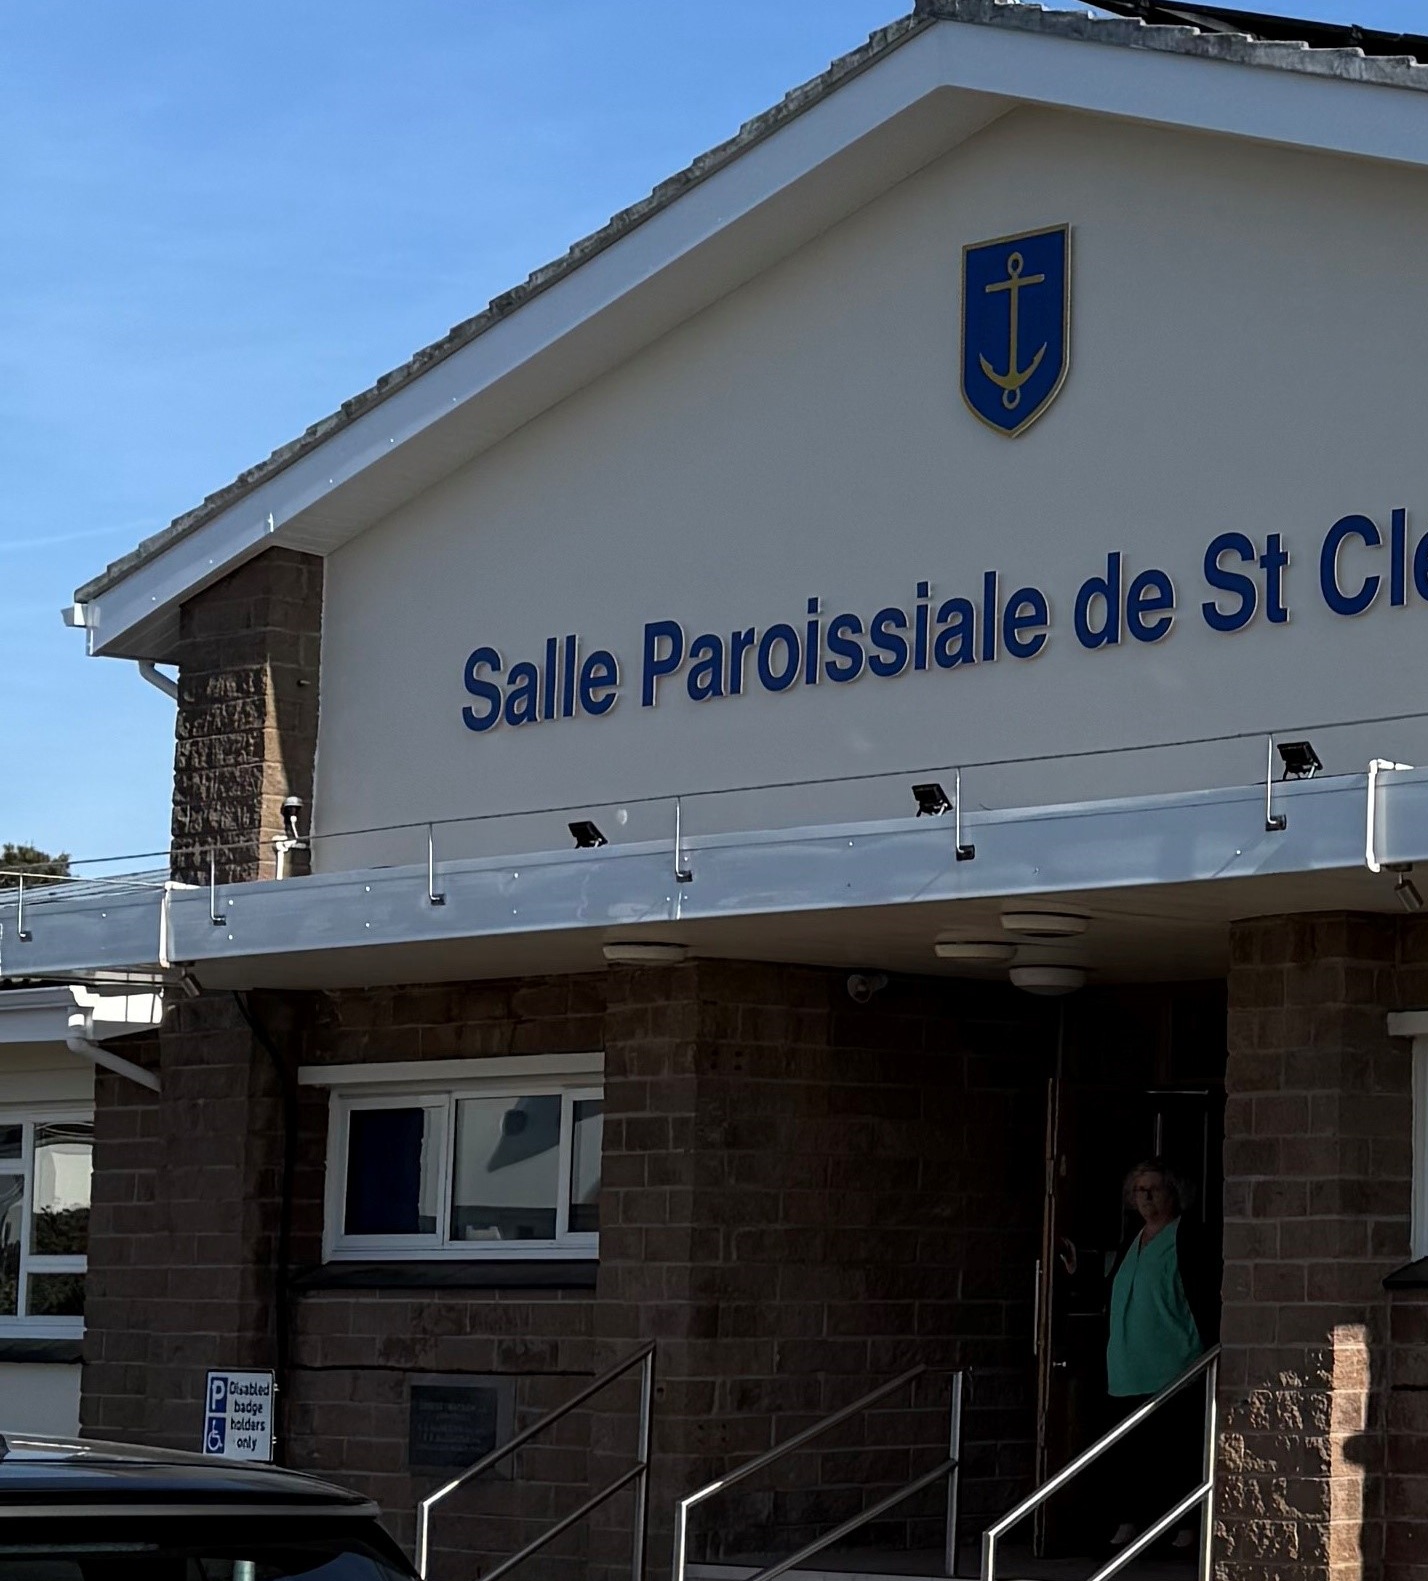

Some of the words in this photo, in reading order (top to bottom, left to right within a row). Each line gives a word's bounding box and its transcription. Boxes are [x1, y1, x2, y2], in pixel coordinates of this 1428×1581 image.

[462, 635, 619, 732] Salle
[641, 570, 1050, 707] Paroissiale
[1074, 552, 1176, 650] de
[1202, 532, 1290, 632] St
[212, 1379, 225, 1410] P
[229, 1381, 270, 1396] Disabled
[234, 1399, 263, 1416] badge
[230, 1417, 265, 1432] holders
[236, 1436, 257, 1451] only
